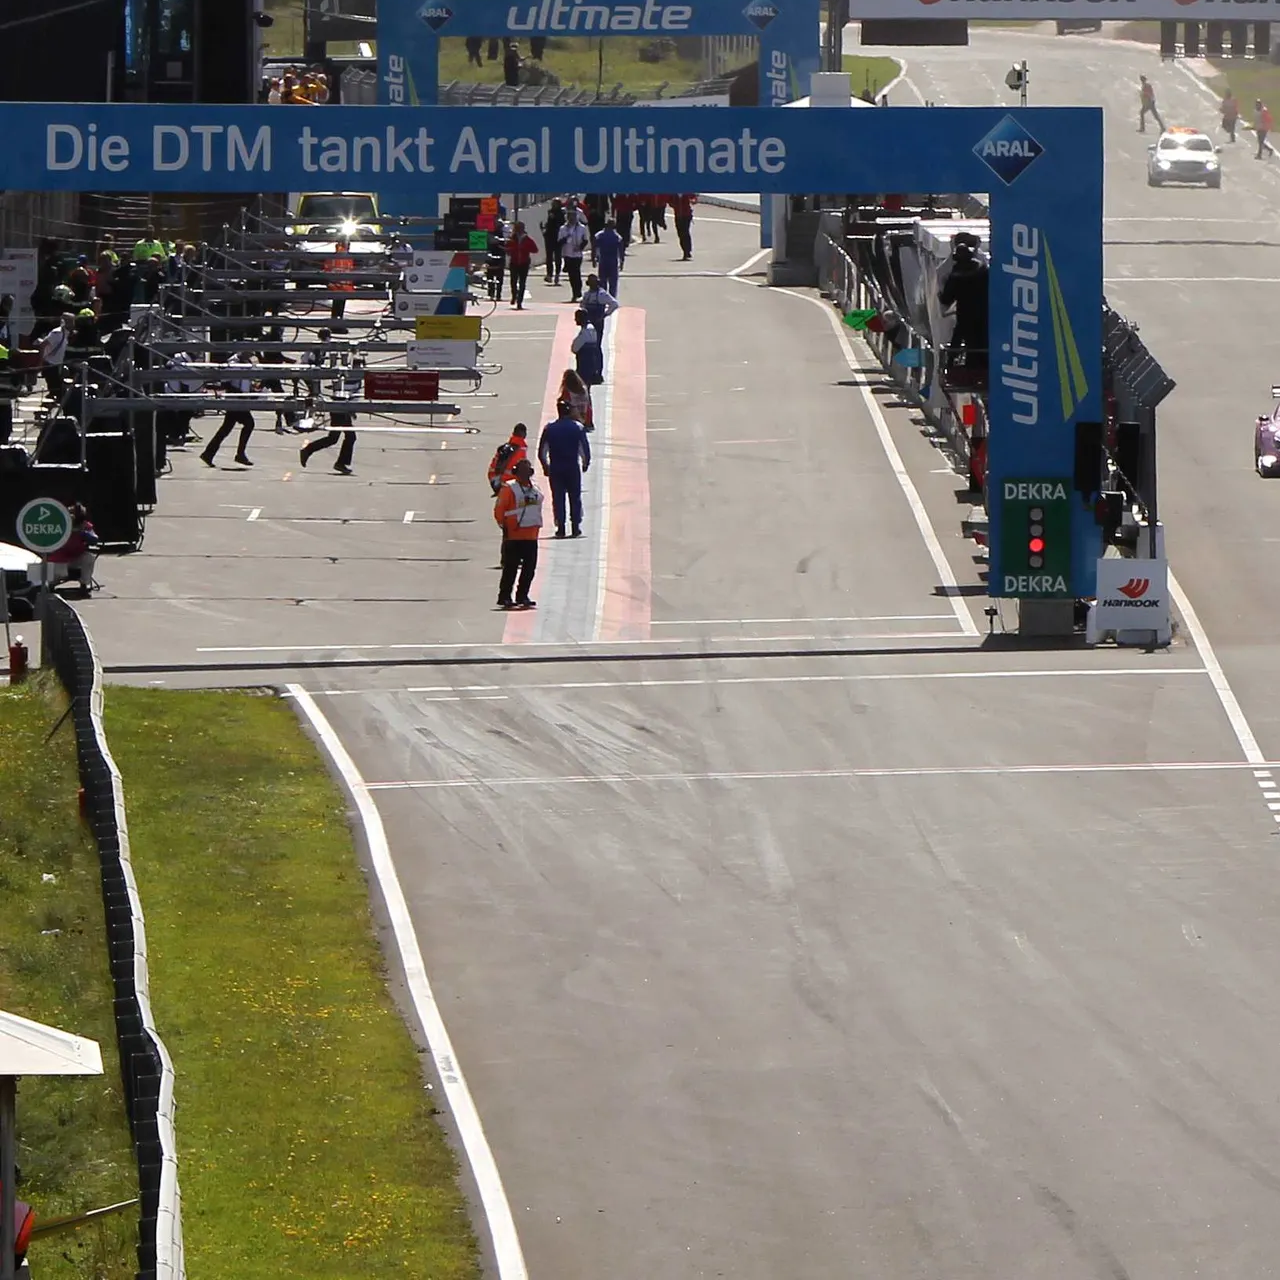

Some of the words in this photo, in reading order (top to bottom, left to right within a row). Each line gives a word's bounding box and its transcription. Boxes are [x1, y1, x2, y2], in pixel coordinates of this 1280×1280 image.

[421, 8, 449, 18] ARAL
[747, 6, 776, 17] ARAL
[48, 124, 129, 171] Die
[153, 125, 271, 172] DTM
[299, 127, 435, 173] tankt
[450, 127, 550, 173] Aral
[574, 127, 785, 173] Ultimate
[982, 141, 1034, 157] ARAL
[1002, 223, 1038, 425] ultimate
[1004, 483, 1067, 500] DEKRA
[24, 520, 63, 536] DEKRA
[1004, 575, 1067, 593] DEKRA
